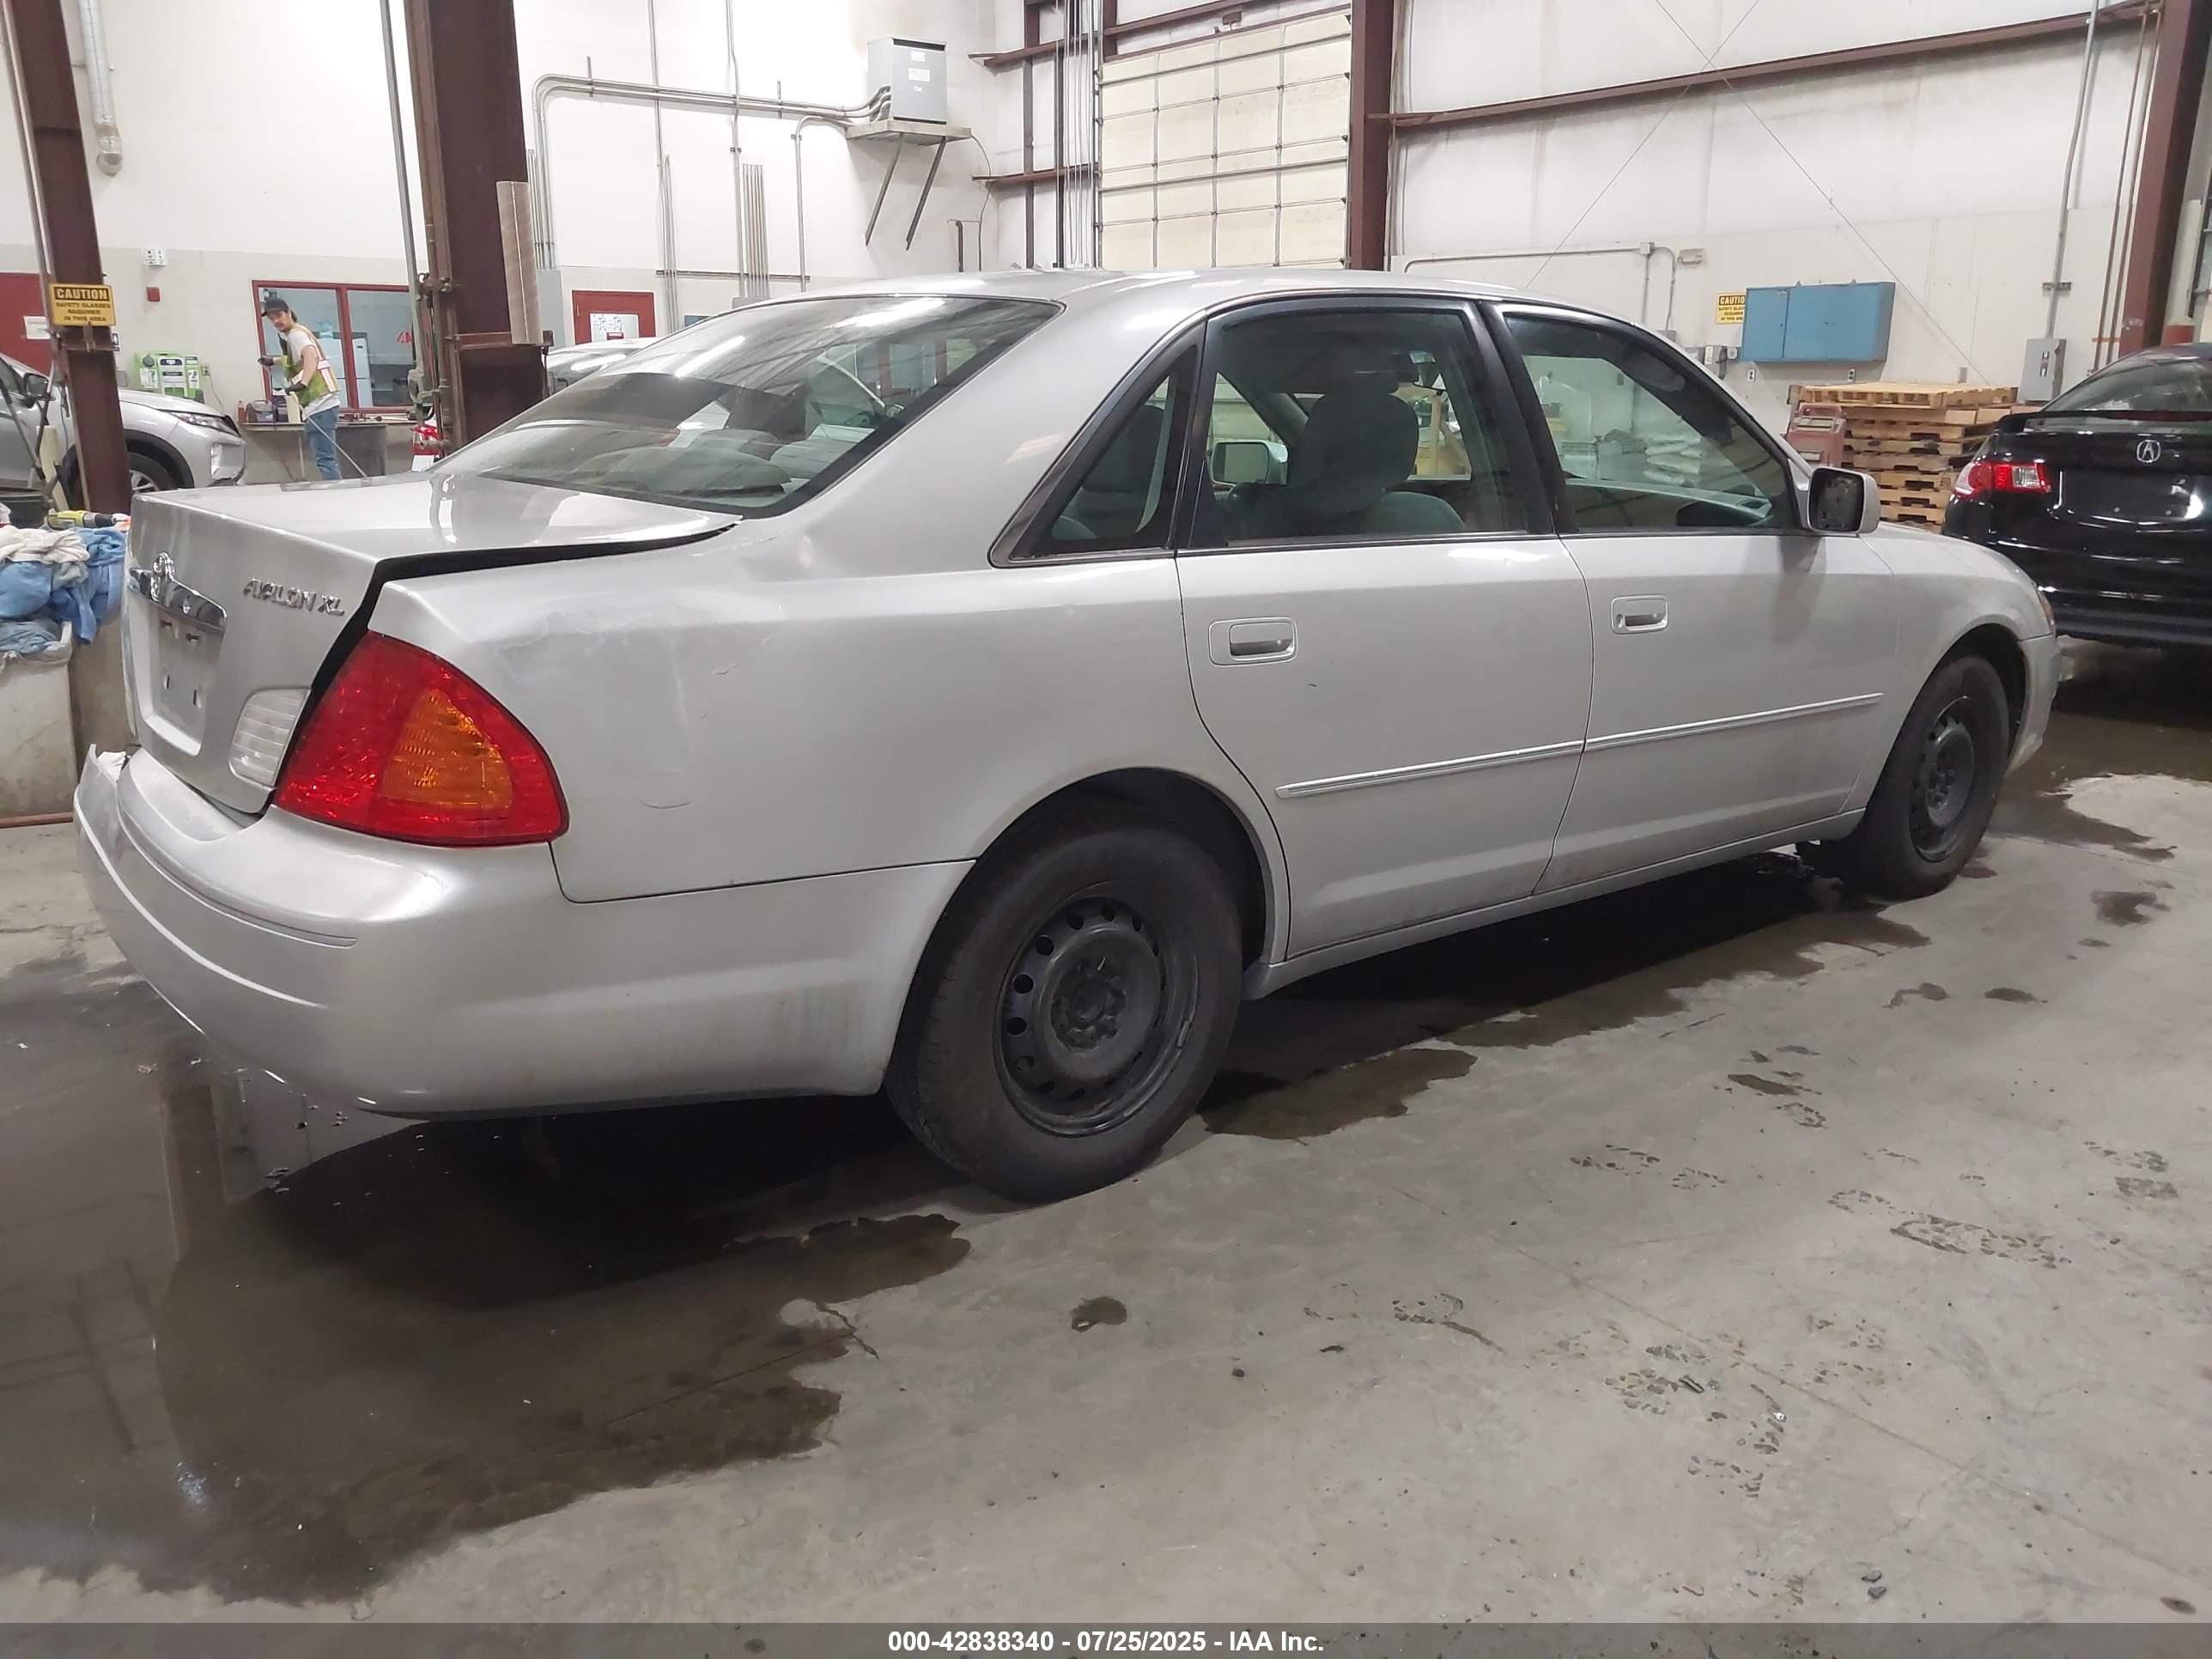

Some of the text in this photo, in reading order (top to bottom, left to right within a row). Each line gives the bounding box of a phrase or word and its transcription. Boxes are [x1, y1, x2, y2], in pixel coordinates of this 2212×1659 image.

[56, 288, 107, 300] CAUTION
[1720, 295, 1745, 305] CAUTIO
[243, 578, 345, 617] AVALON XL
